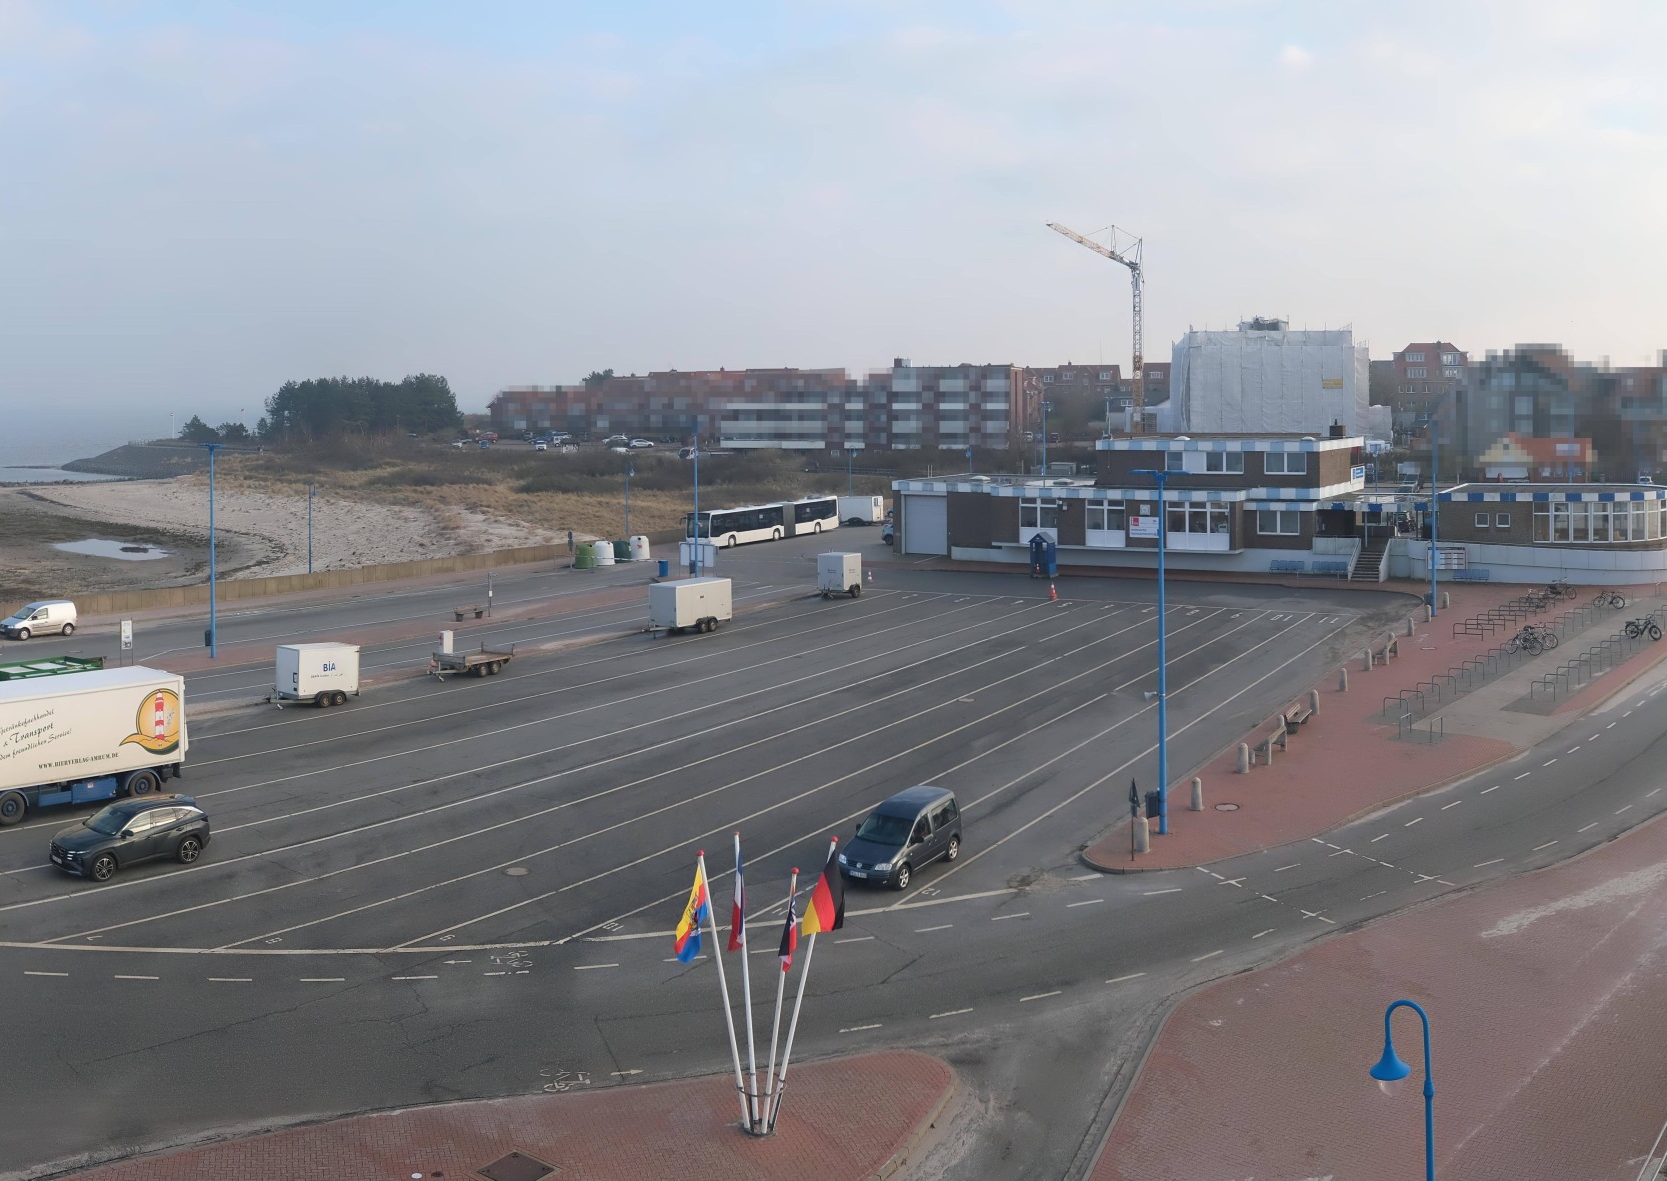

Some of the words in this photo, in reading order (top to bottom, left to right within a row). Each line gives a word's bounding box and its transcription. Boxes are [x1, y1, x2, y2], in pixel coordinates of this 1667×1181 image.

[9, 722, 54, 744] Transport
[0, 752, 11, 761] dem
[12, 739, 47, 759] freundlichen
